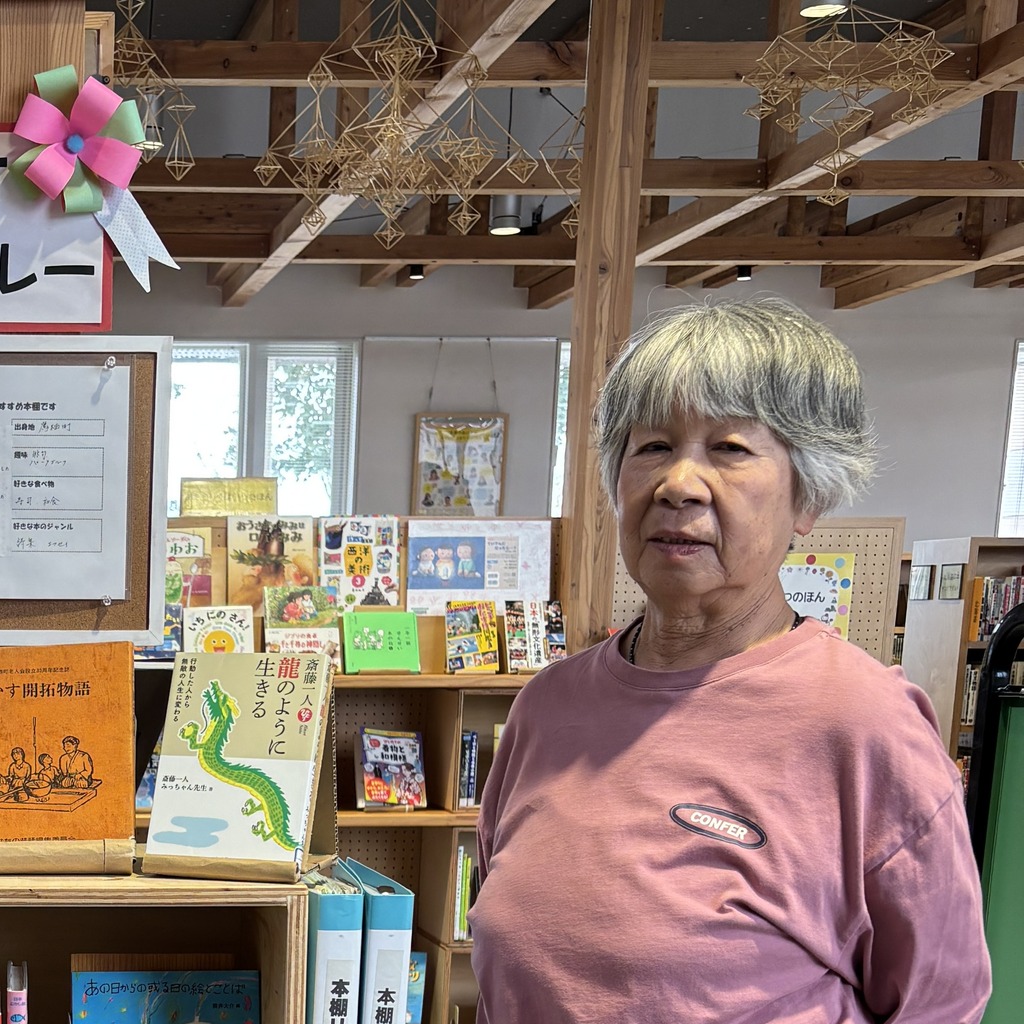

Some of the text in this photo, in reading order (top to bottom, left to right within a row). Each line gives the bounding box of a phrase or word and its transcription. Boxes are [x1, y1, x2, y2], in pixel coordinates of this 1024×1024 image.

[14, 423, 35, 431] 出身地
[14, 451, 28, 459] 趣味
[14, 480, 54, 488] 好きな食べ物
[348, 546, 370, 555] 西洋
[348, 565, 370, 575] 美術
[188, 617, 205, 631] いち
[206, 610, 226, 621] にの
[281, 639, 325, 649] 千と千尋の神隠し
[184, 658, 197, 708] 行動した人から
[252, 657, 276, 719] 生きる
[300, 658, 320, 706] 斎藤一人
[173, 658, 188, 722] 無敵の人生に変わる
[268, 657, 301, 756] 龍のように
[162, 775, 190, 784] 斎藤一人
[161, 782, 207, 792] みっちゃん先生
[690, 811, 748, 840] CONFER
[85, 979, 246, 996] あの日からの或る日の絵とことば
